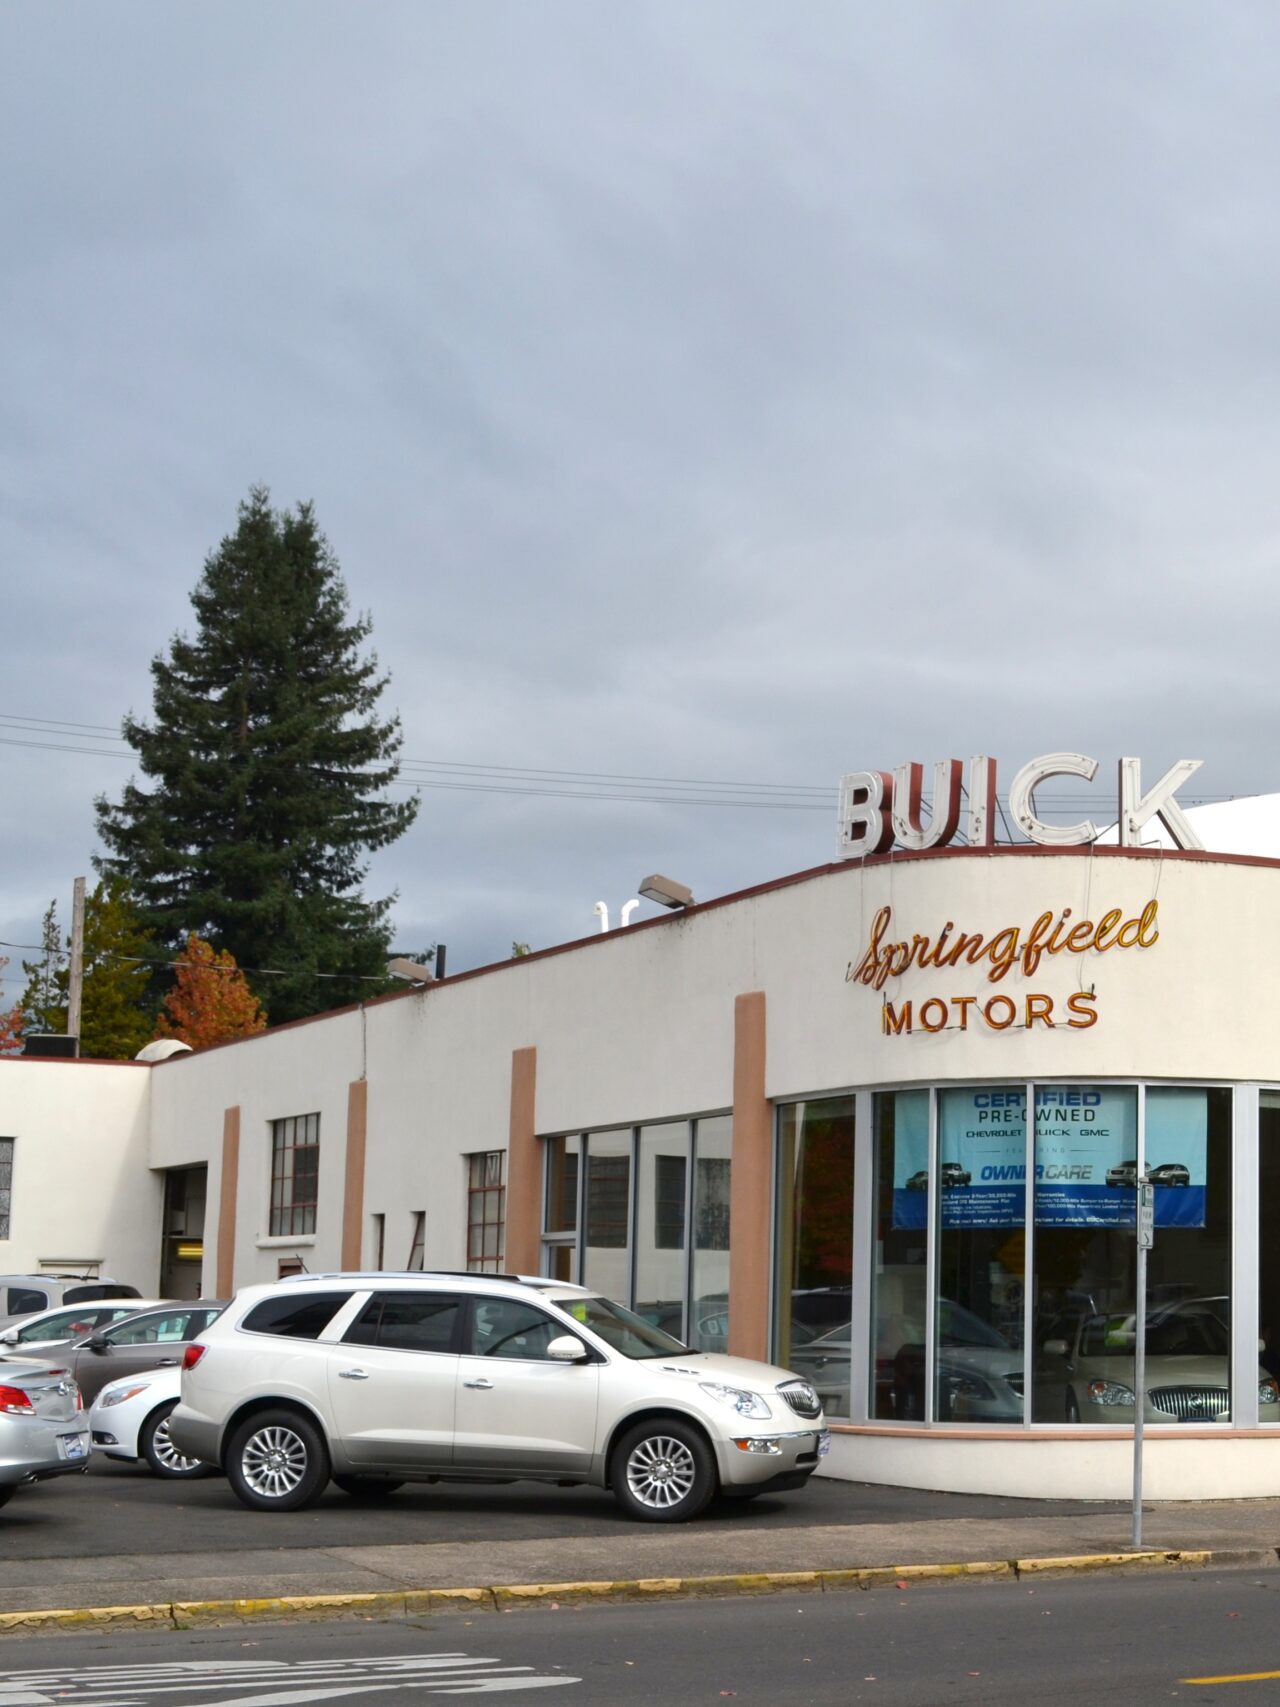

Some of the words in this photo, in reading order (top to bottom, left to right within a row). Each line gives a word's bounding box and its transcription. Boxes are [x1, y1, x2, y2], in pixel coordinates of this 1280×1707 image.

[836, 752, 1205, 859] BUICK
[848, 899, 1159, 990] Springfield
[881, 992, 1098, 1036] MOTORS
[966, 1129, 1023, 1138] CHEVROLET
[1031, 1128, 1071, 1137] UICK
[1079, 1129, 1110, 1137] GMC
[980, 1164, 1094, 1181] OWNRCARE
